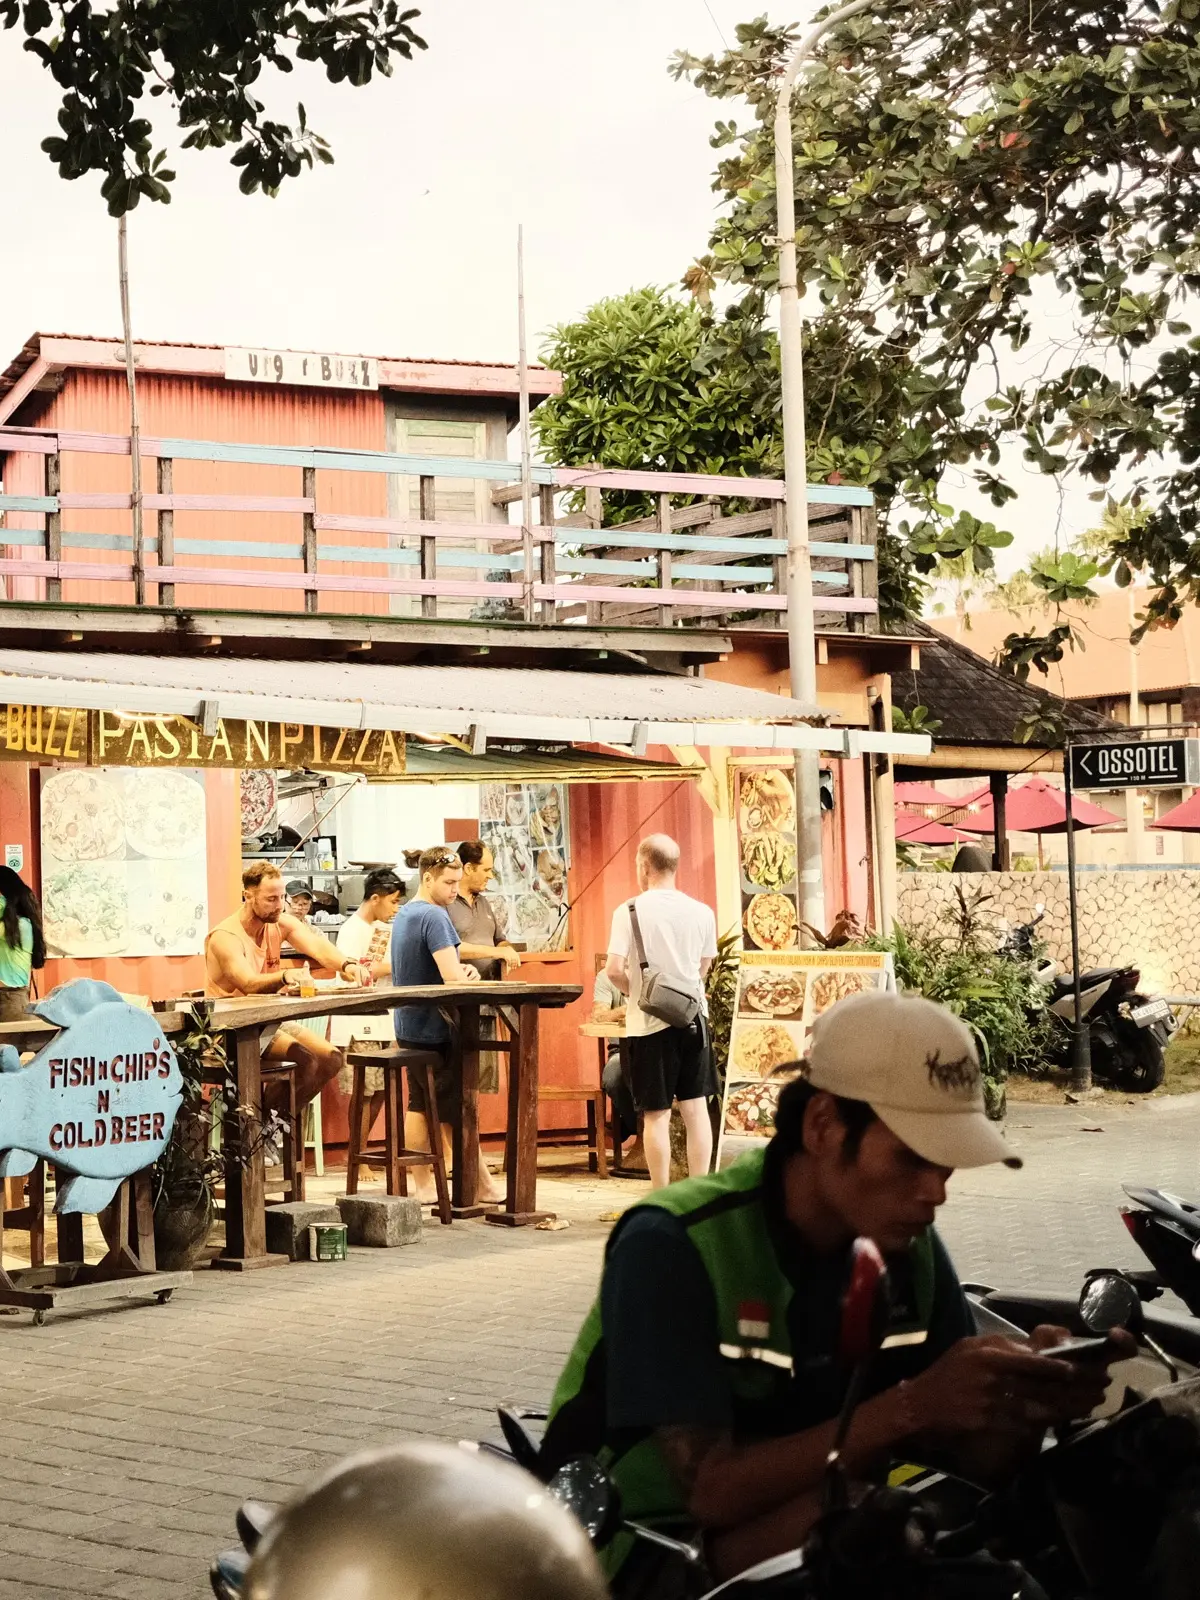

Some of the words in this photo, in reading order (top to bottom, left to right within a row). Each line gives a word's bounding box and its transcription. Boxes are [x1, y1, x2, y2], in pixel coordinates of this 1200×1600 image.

[6, 704, 79, 758] BUZZ
[279, 722, 401, 768] PIZZA
[1098, 745, 1178, 775] OSSOTEL
[49, 1056, 96, 1089] FISH
[97, 1089, 110, 1114] N
[49, 1118, 107, 1151] COLD
[110, 1112, 165, 1145] BEER
